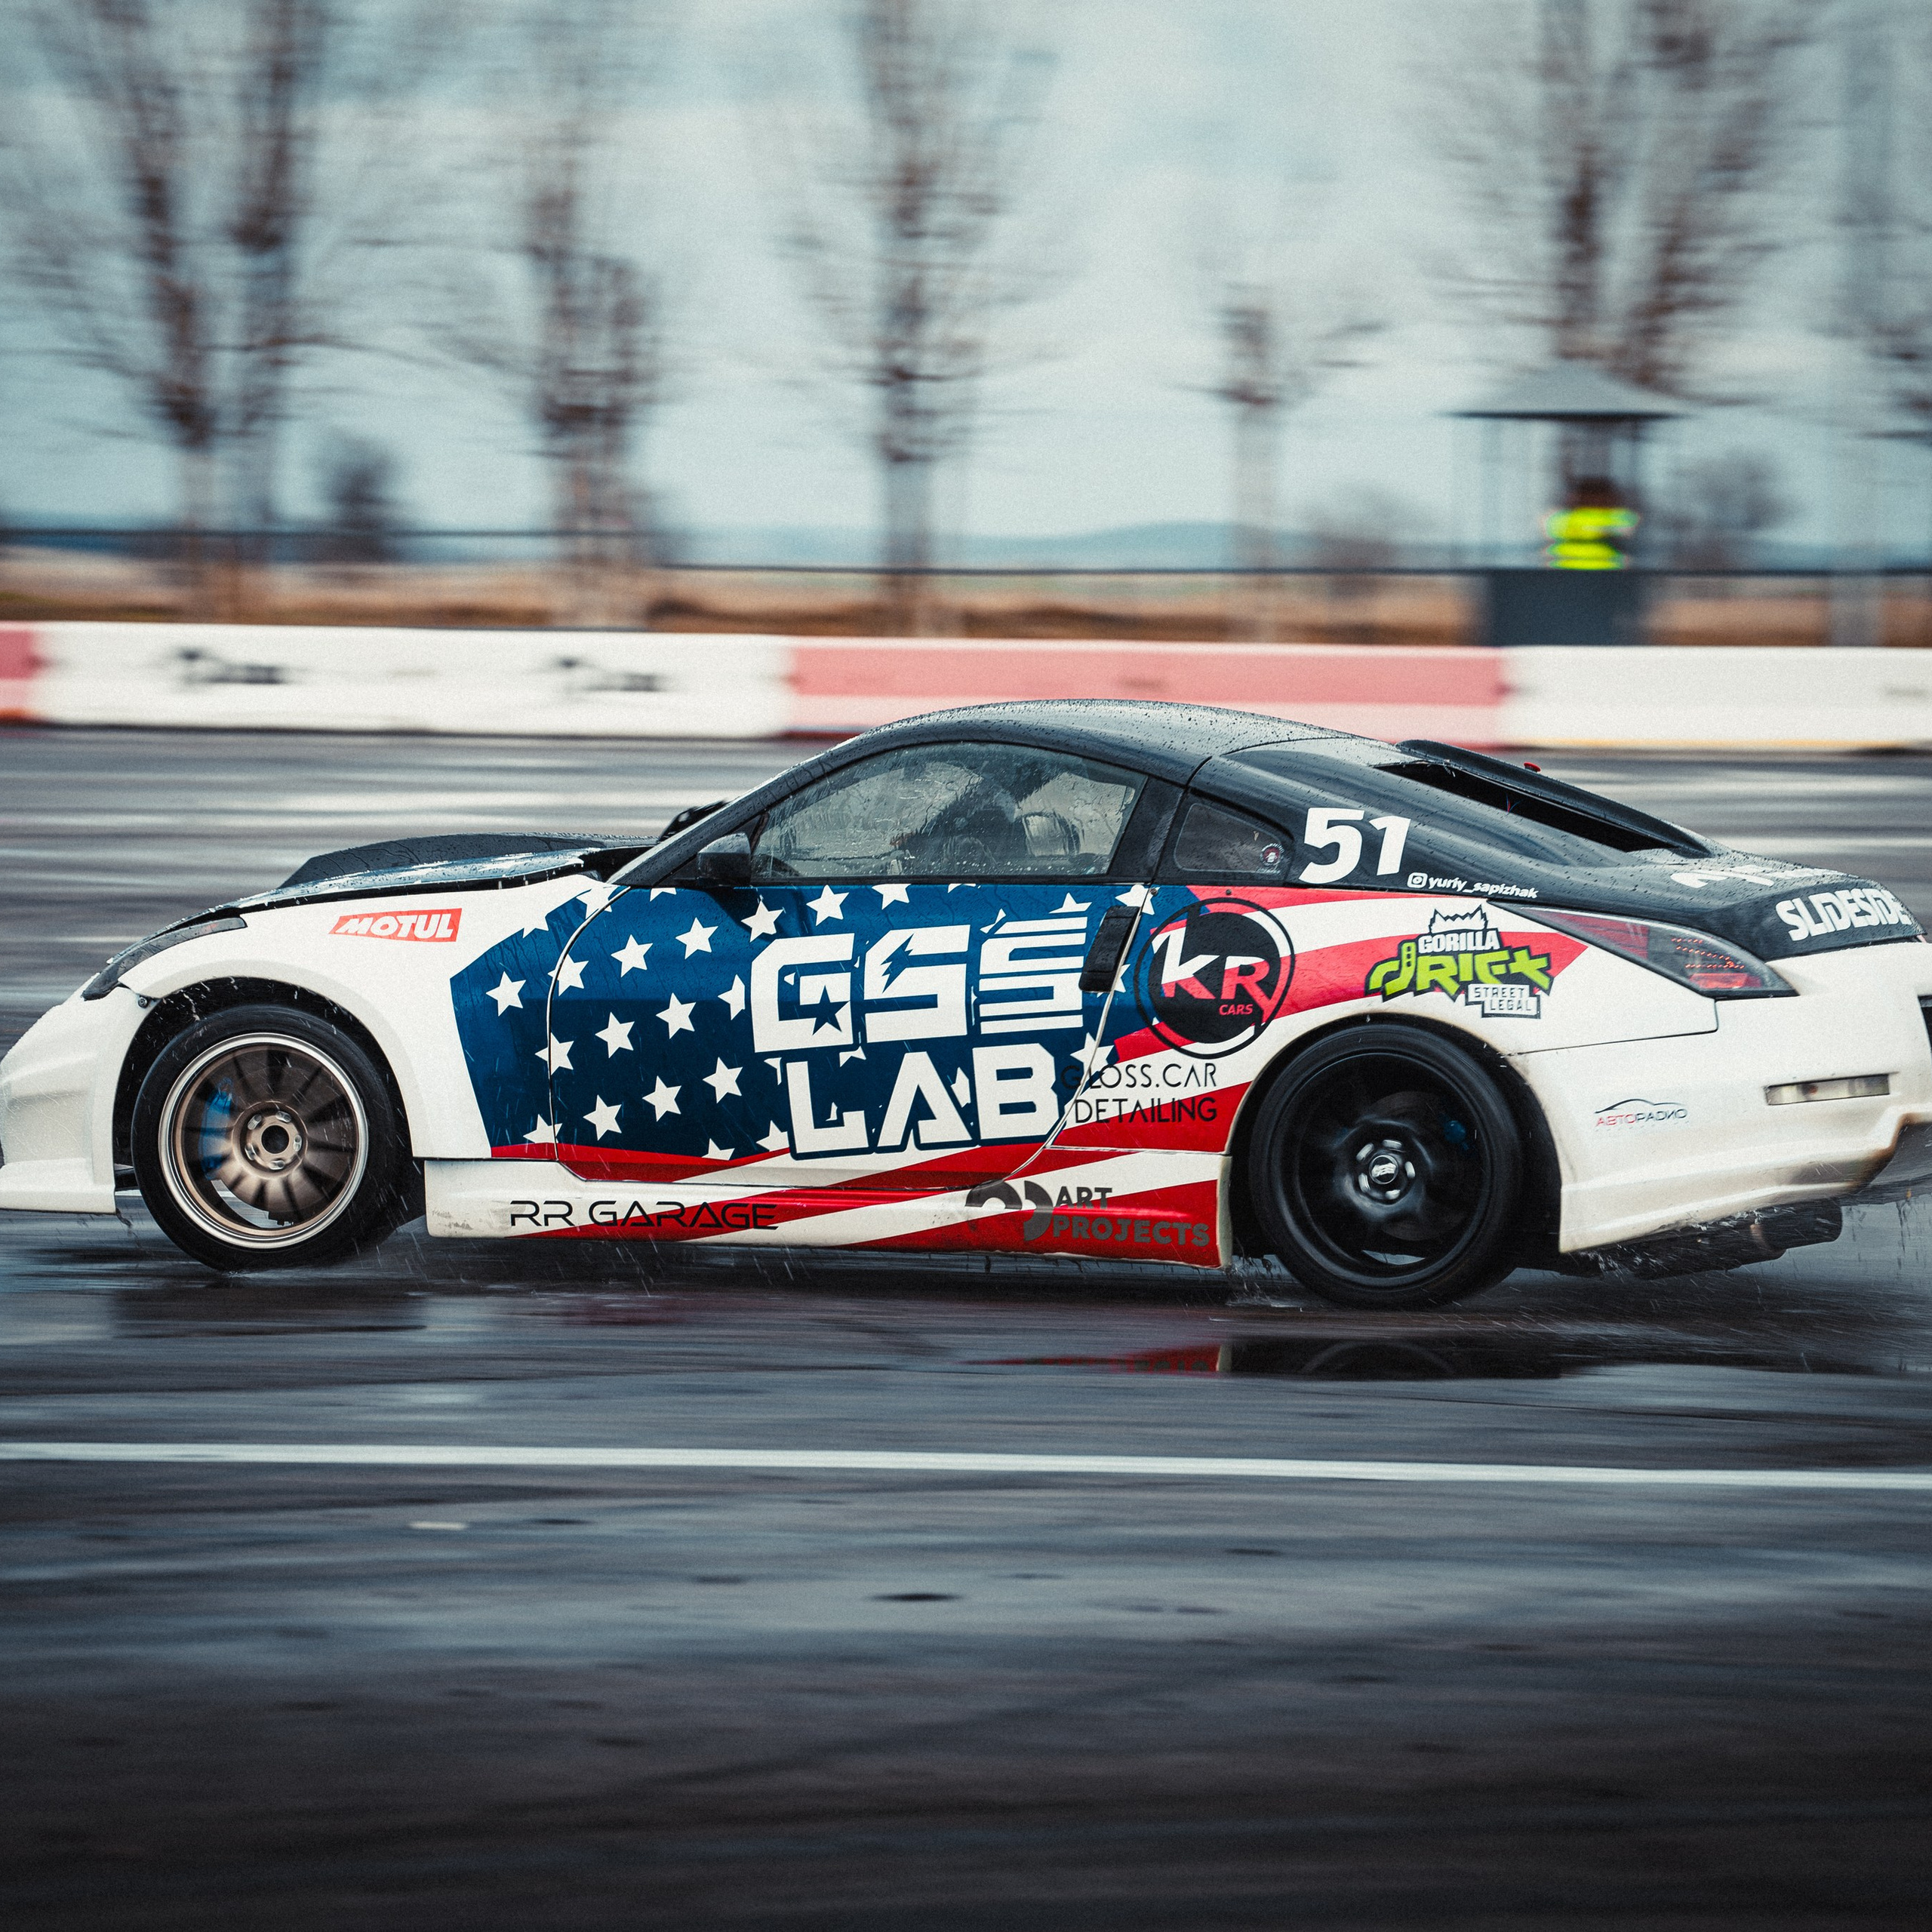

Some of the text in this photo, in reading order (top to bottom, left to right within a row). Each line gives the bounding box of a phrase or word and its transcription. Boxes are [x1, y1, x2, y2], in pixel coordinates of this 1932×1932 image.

[1299, 808, 1411, 884] 51
[1428, 877, 1539, 898] yuriy_sapizhak
[335, 913, 453, 939] MOTUL
[1418, 930, 1500, 953] GORILLA
[1151, 922, 1272, 1017] KR
[750, 916, 1088, 1053] GSS
[1474, 986, 1524, 998] STREET
[1219, 1004, 1254, 1016] CARS
[1490, 998, 1532, 1011] LEGAL
[786, 1043, 1060, 1153] LAB
[1074, 1097, 1217, 1123] DETAILING
[1057, 1186, 1113, 1209] ART
[510, 1201, 780, 1230] RR GARAGE
[1054, 1215, 1211, 1247] PROJECTS
